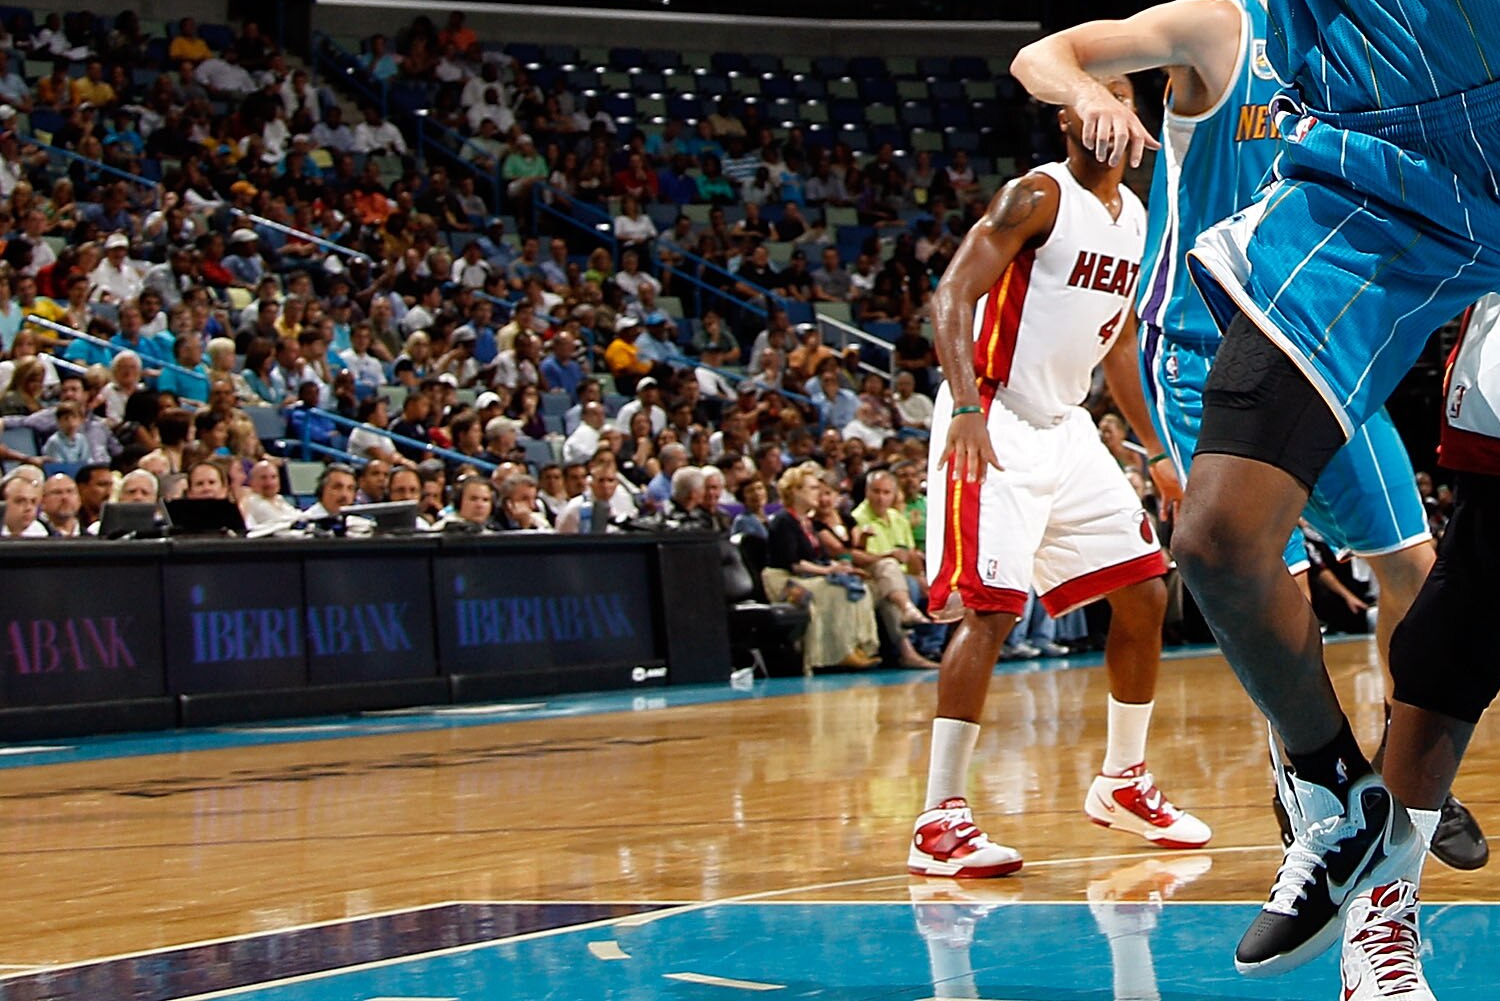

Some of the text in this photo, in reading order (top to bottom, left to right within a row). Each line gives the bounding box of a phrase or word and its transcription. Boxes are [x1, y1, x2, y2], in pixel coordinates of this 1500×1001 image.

[1067, 250, 1140, 299] HEAT
[1097, 307, 1124, 346] 4
[6, 616, 136, 676] ABANK
